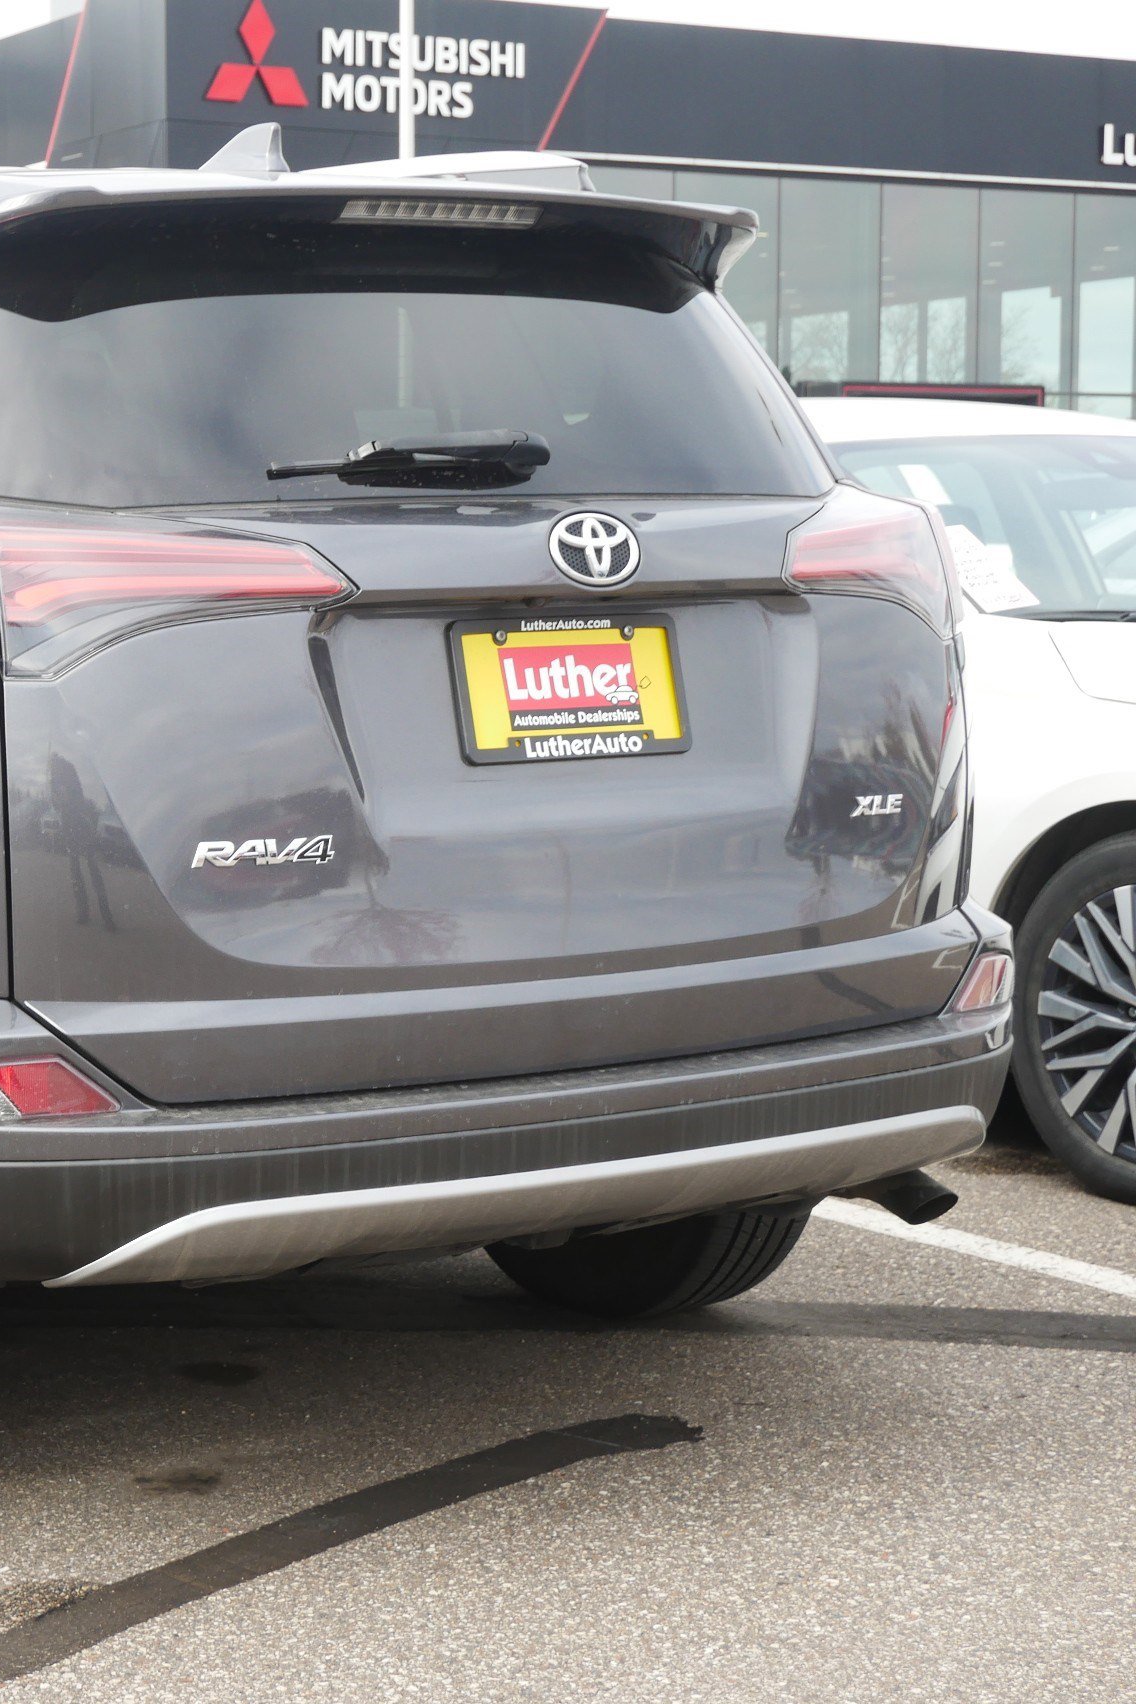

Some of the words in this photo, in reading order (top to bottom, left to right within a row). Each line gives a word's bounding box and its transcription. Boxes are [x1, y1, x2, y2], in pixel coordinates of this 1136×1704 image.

[321, 27, 526, 79] MITSUBISHI
[321, 72, 474, 119] MOTORS
[520, 618, 612, 632] LutherAuto.com
[503, 655, 632, 701] Luther
[514, 711, 577, 727] Automobile
[577, 708, 641, 724] Dealerships
[524, 732, 643, 758] LutherAuto
[849, 793, 904, 818] XLE
[190, 834, 336, 869] RAV4
